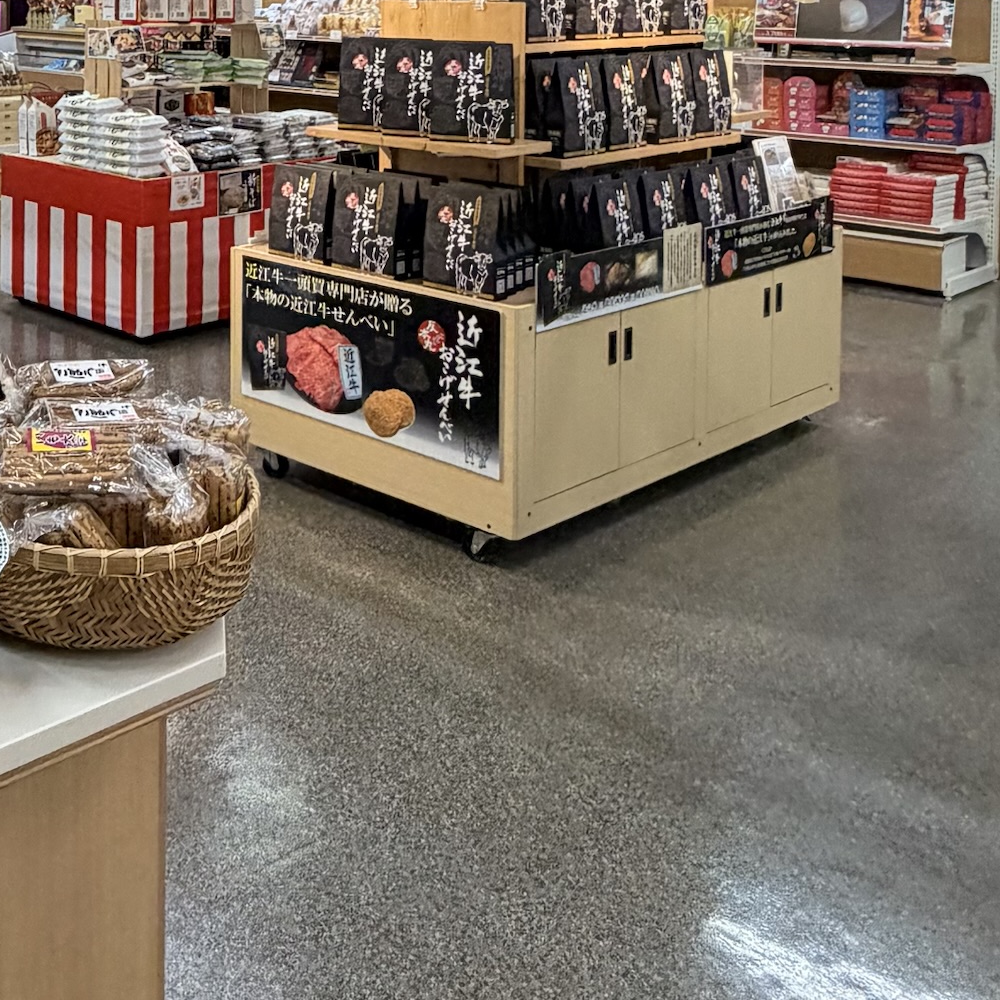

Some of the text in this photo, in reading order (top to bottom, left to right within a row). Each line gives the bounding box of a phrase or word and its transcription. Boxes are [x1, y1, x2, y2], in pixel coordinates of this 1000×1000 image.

[245, 263, 413, 316] 近江牛一頭買専門店が贈る
[245, 285, 395, 337] 「本物の近江牛せんべい」
[343, 348, 360, 395] 近江牛
[455, 310, 483, 410] 近江牛
